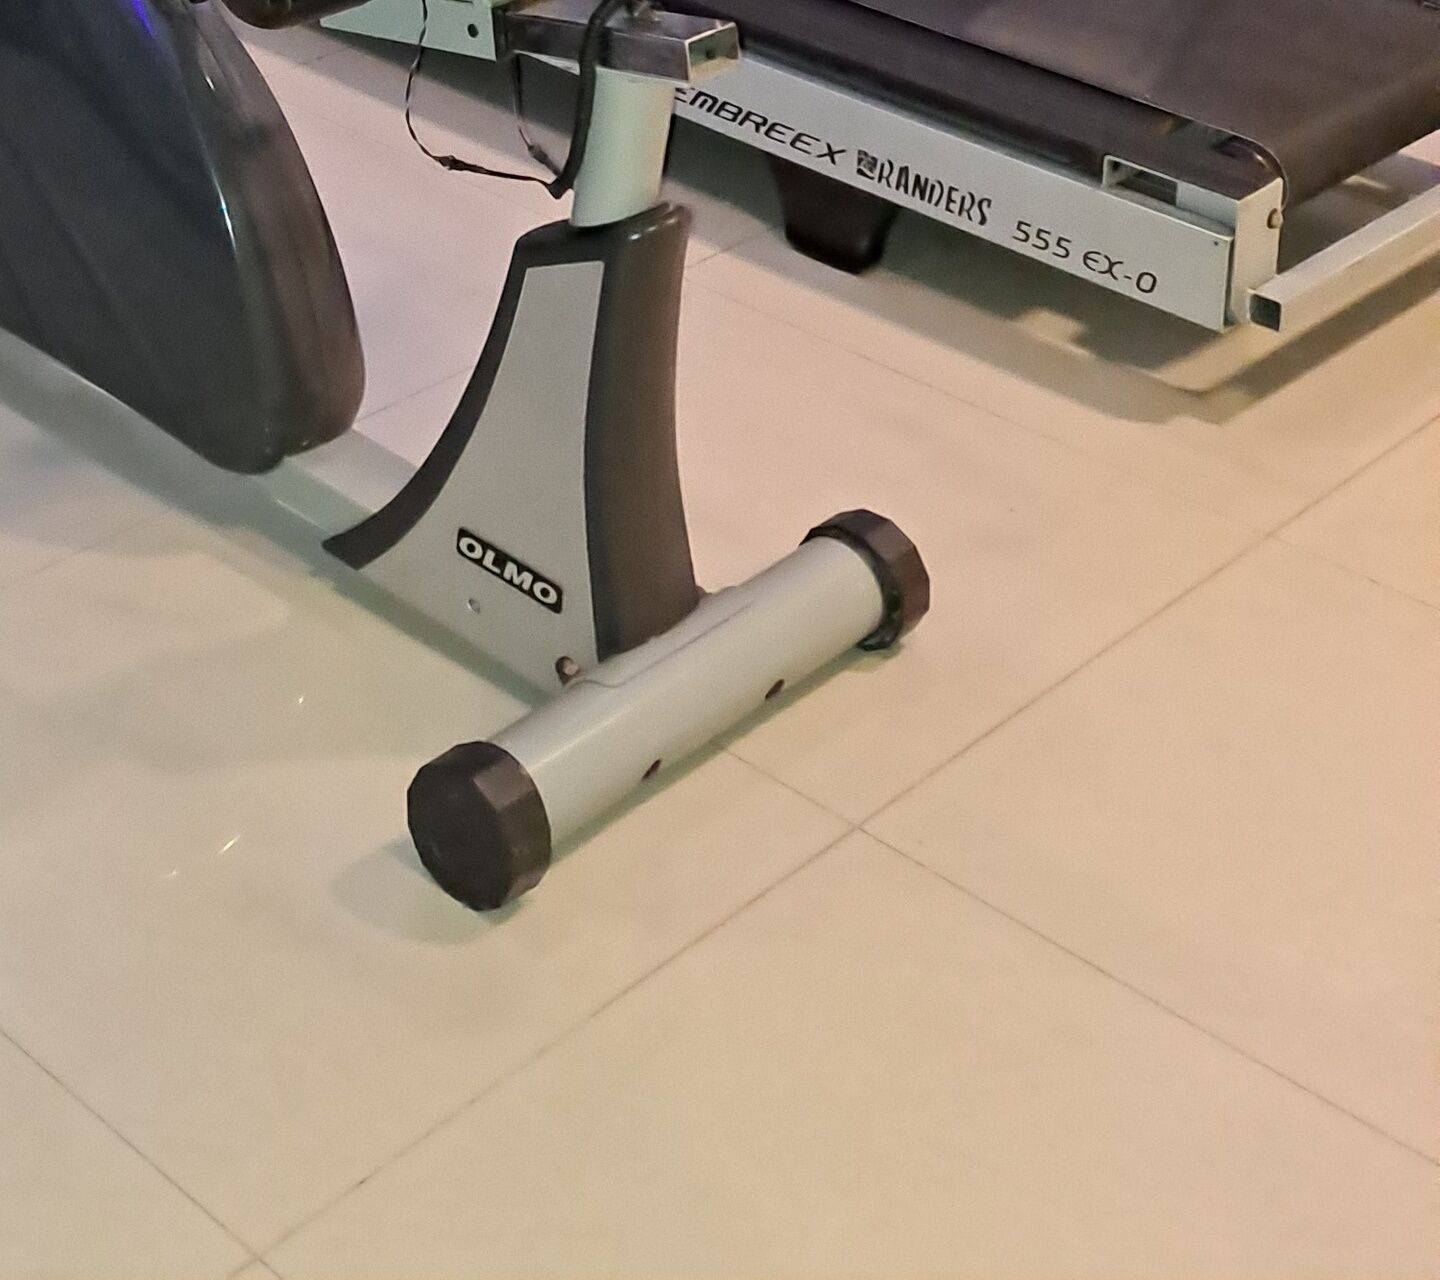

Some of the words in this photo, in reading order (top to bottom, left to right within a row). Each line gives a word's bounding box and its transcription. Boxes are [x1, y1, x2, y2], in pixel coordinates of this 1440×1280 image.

[877, 159, 991, 227] RANDERS
[1012, 220, 1072, 259] 555
[459, 537, 558, 604] OLMO
